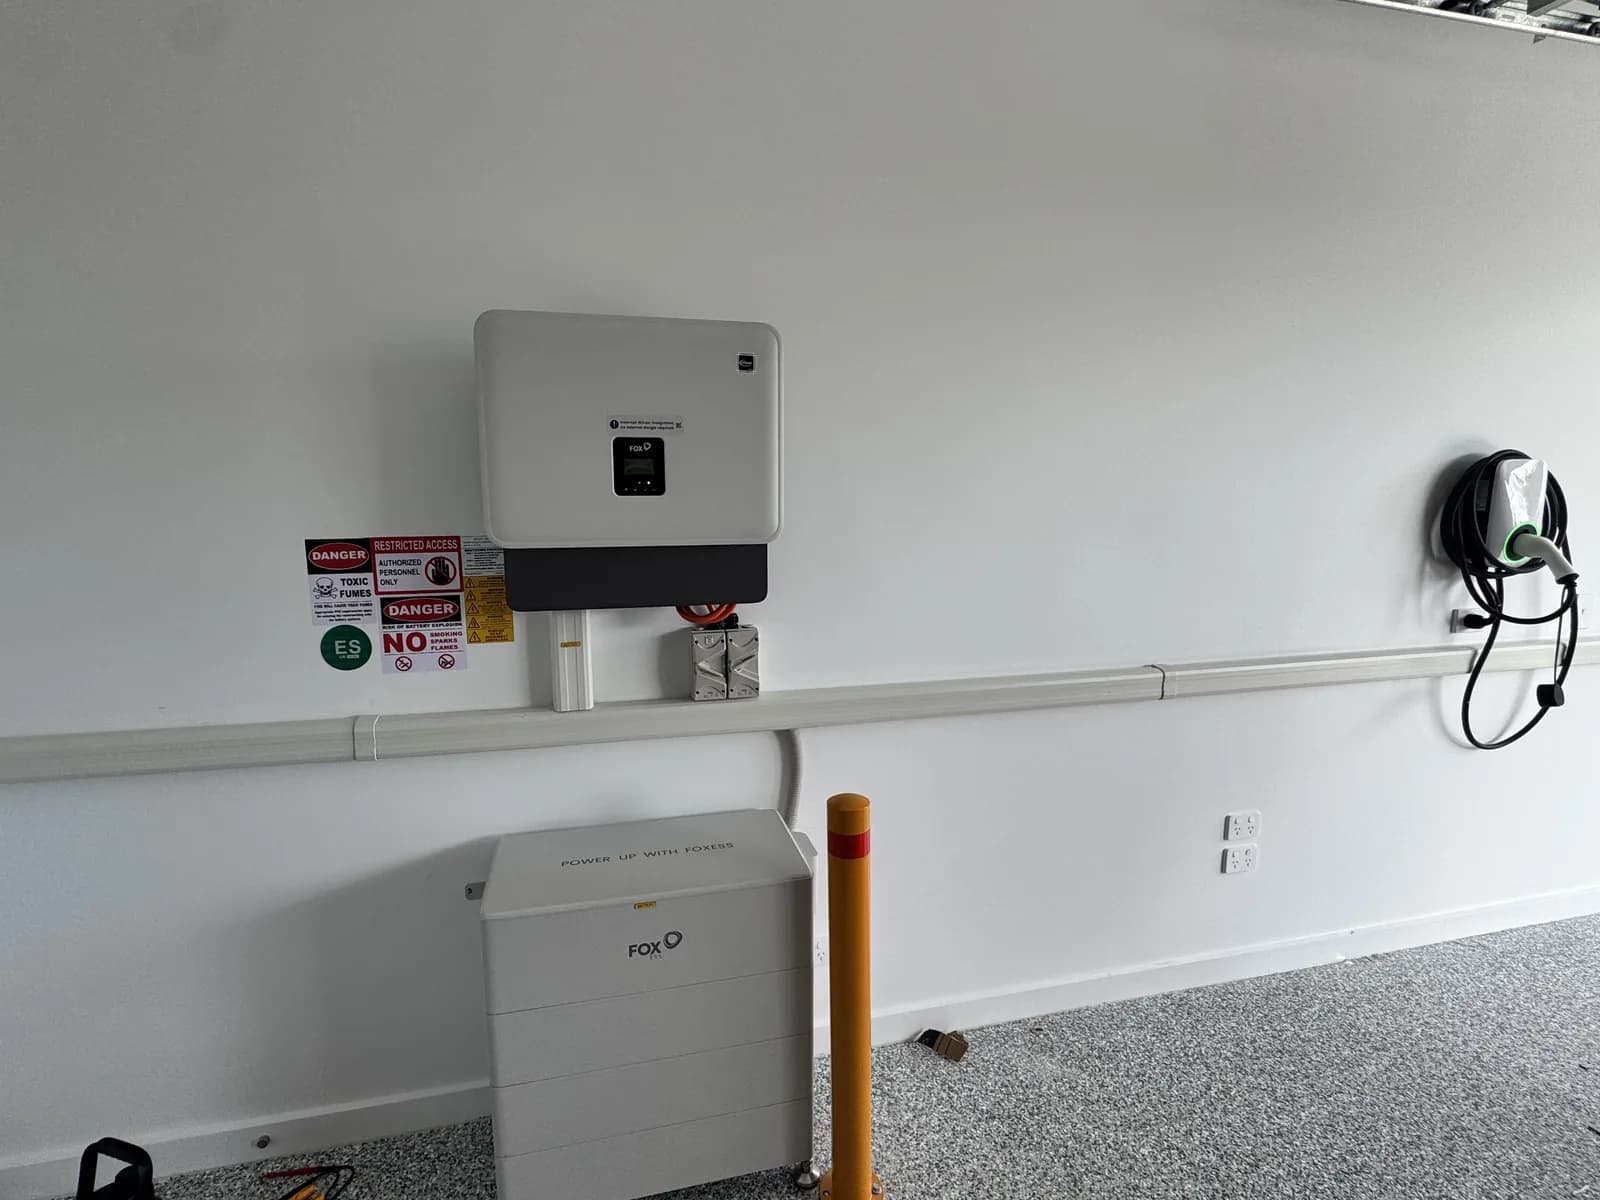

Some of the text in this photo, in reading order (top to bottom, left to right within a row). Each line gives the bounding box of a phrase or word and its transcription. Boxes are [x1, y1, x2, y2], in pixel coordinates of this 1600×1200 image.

[374, 540, 424, 551] RESTRICTED
[426, 539, 458, 550] ACCESS
[312, 550, 366, 561] DANGER
[378, 558, 422, 567] AUTHORIZED
[379, 568, 420, 576] PERSONNEL
[340, 578, 369, 586] TOXIC
[380, 578, 398, 586] ONLY
[340, 589, 371, 598] FUMES
[389, 604, 454, 616] DANGER
[334, 639, 361, 655] ES
[383, 632, 427, 653] NO
[560, 841, 734, 867] POWER UP WITH FOXESS
[628, 940, 661, 958] FOX
